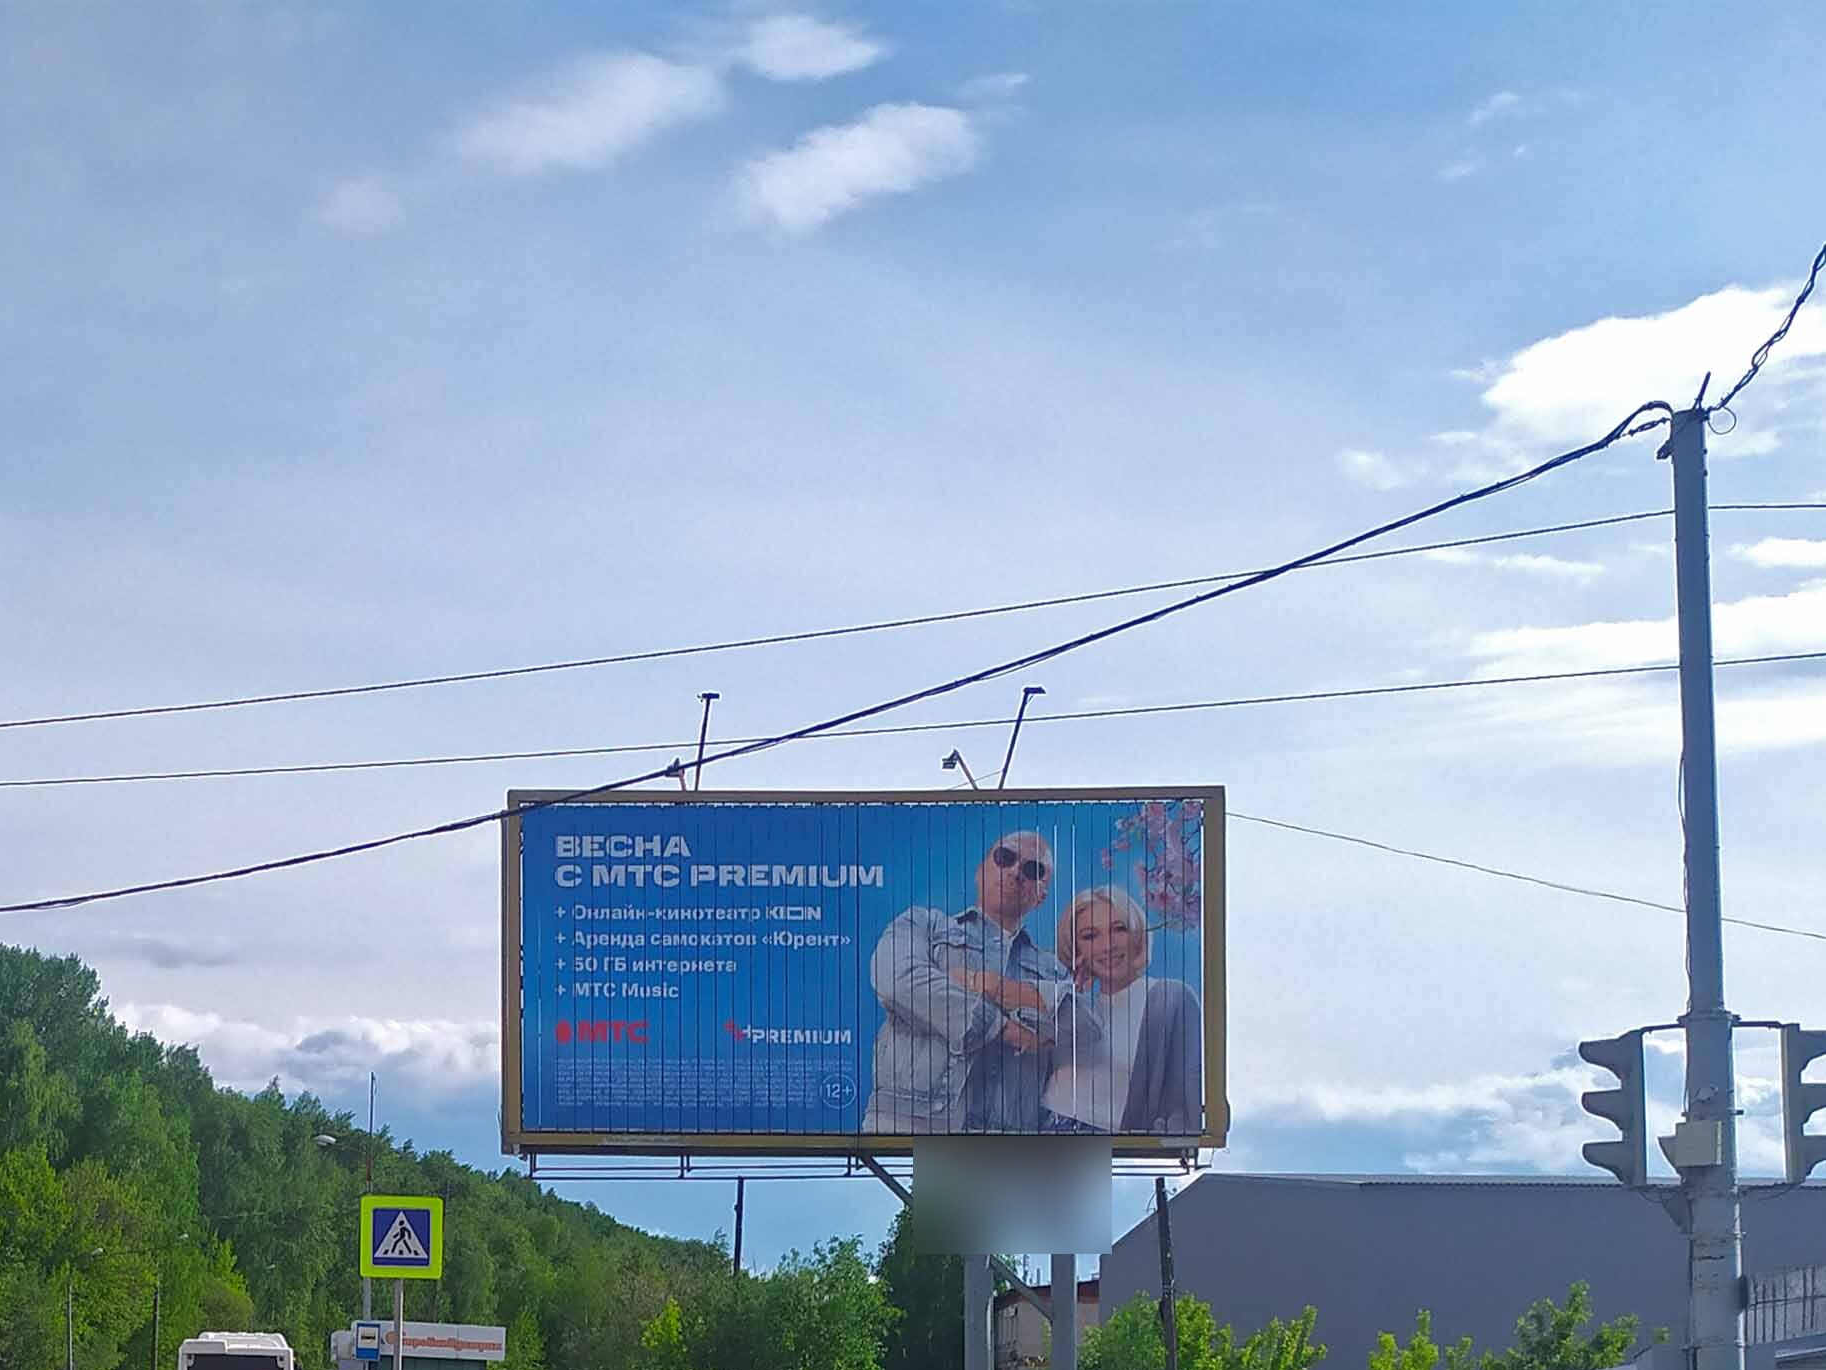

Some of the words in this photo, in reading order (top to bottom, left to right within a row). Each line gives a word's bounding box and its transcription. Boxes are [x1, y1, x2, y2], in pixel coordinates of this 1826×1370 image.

[556, 835, 691, 858] ВЕСНА
[555, 864, 583, 887] С
[592, 864, 680, 887] МТС
[690, 864, 884, 887] PREMIUM
[572, 904, 761, 921] Онлайн-кинотеатр
[572, 931, 645, 949] Аренда
[650, 933, 757, 946] самокатов
[574, 957, 598, 972] 50
[604, 957, 627, 972] ГБ
[632, 958, 738, 975] интернета
[573, 982, 616, 997] МТС
[621, 982, 680, 998] Music
[577, 1021, 650, 1044] МТС
[825, 1083, 853, 1098] 12+
